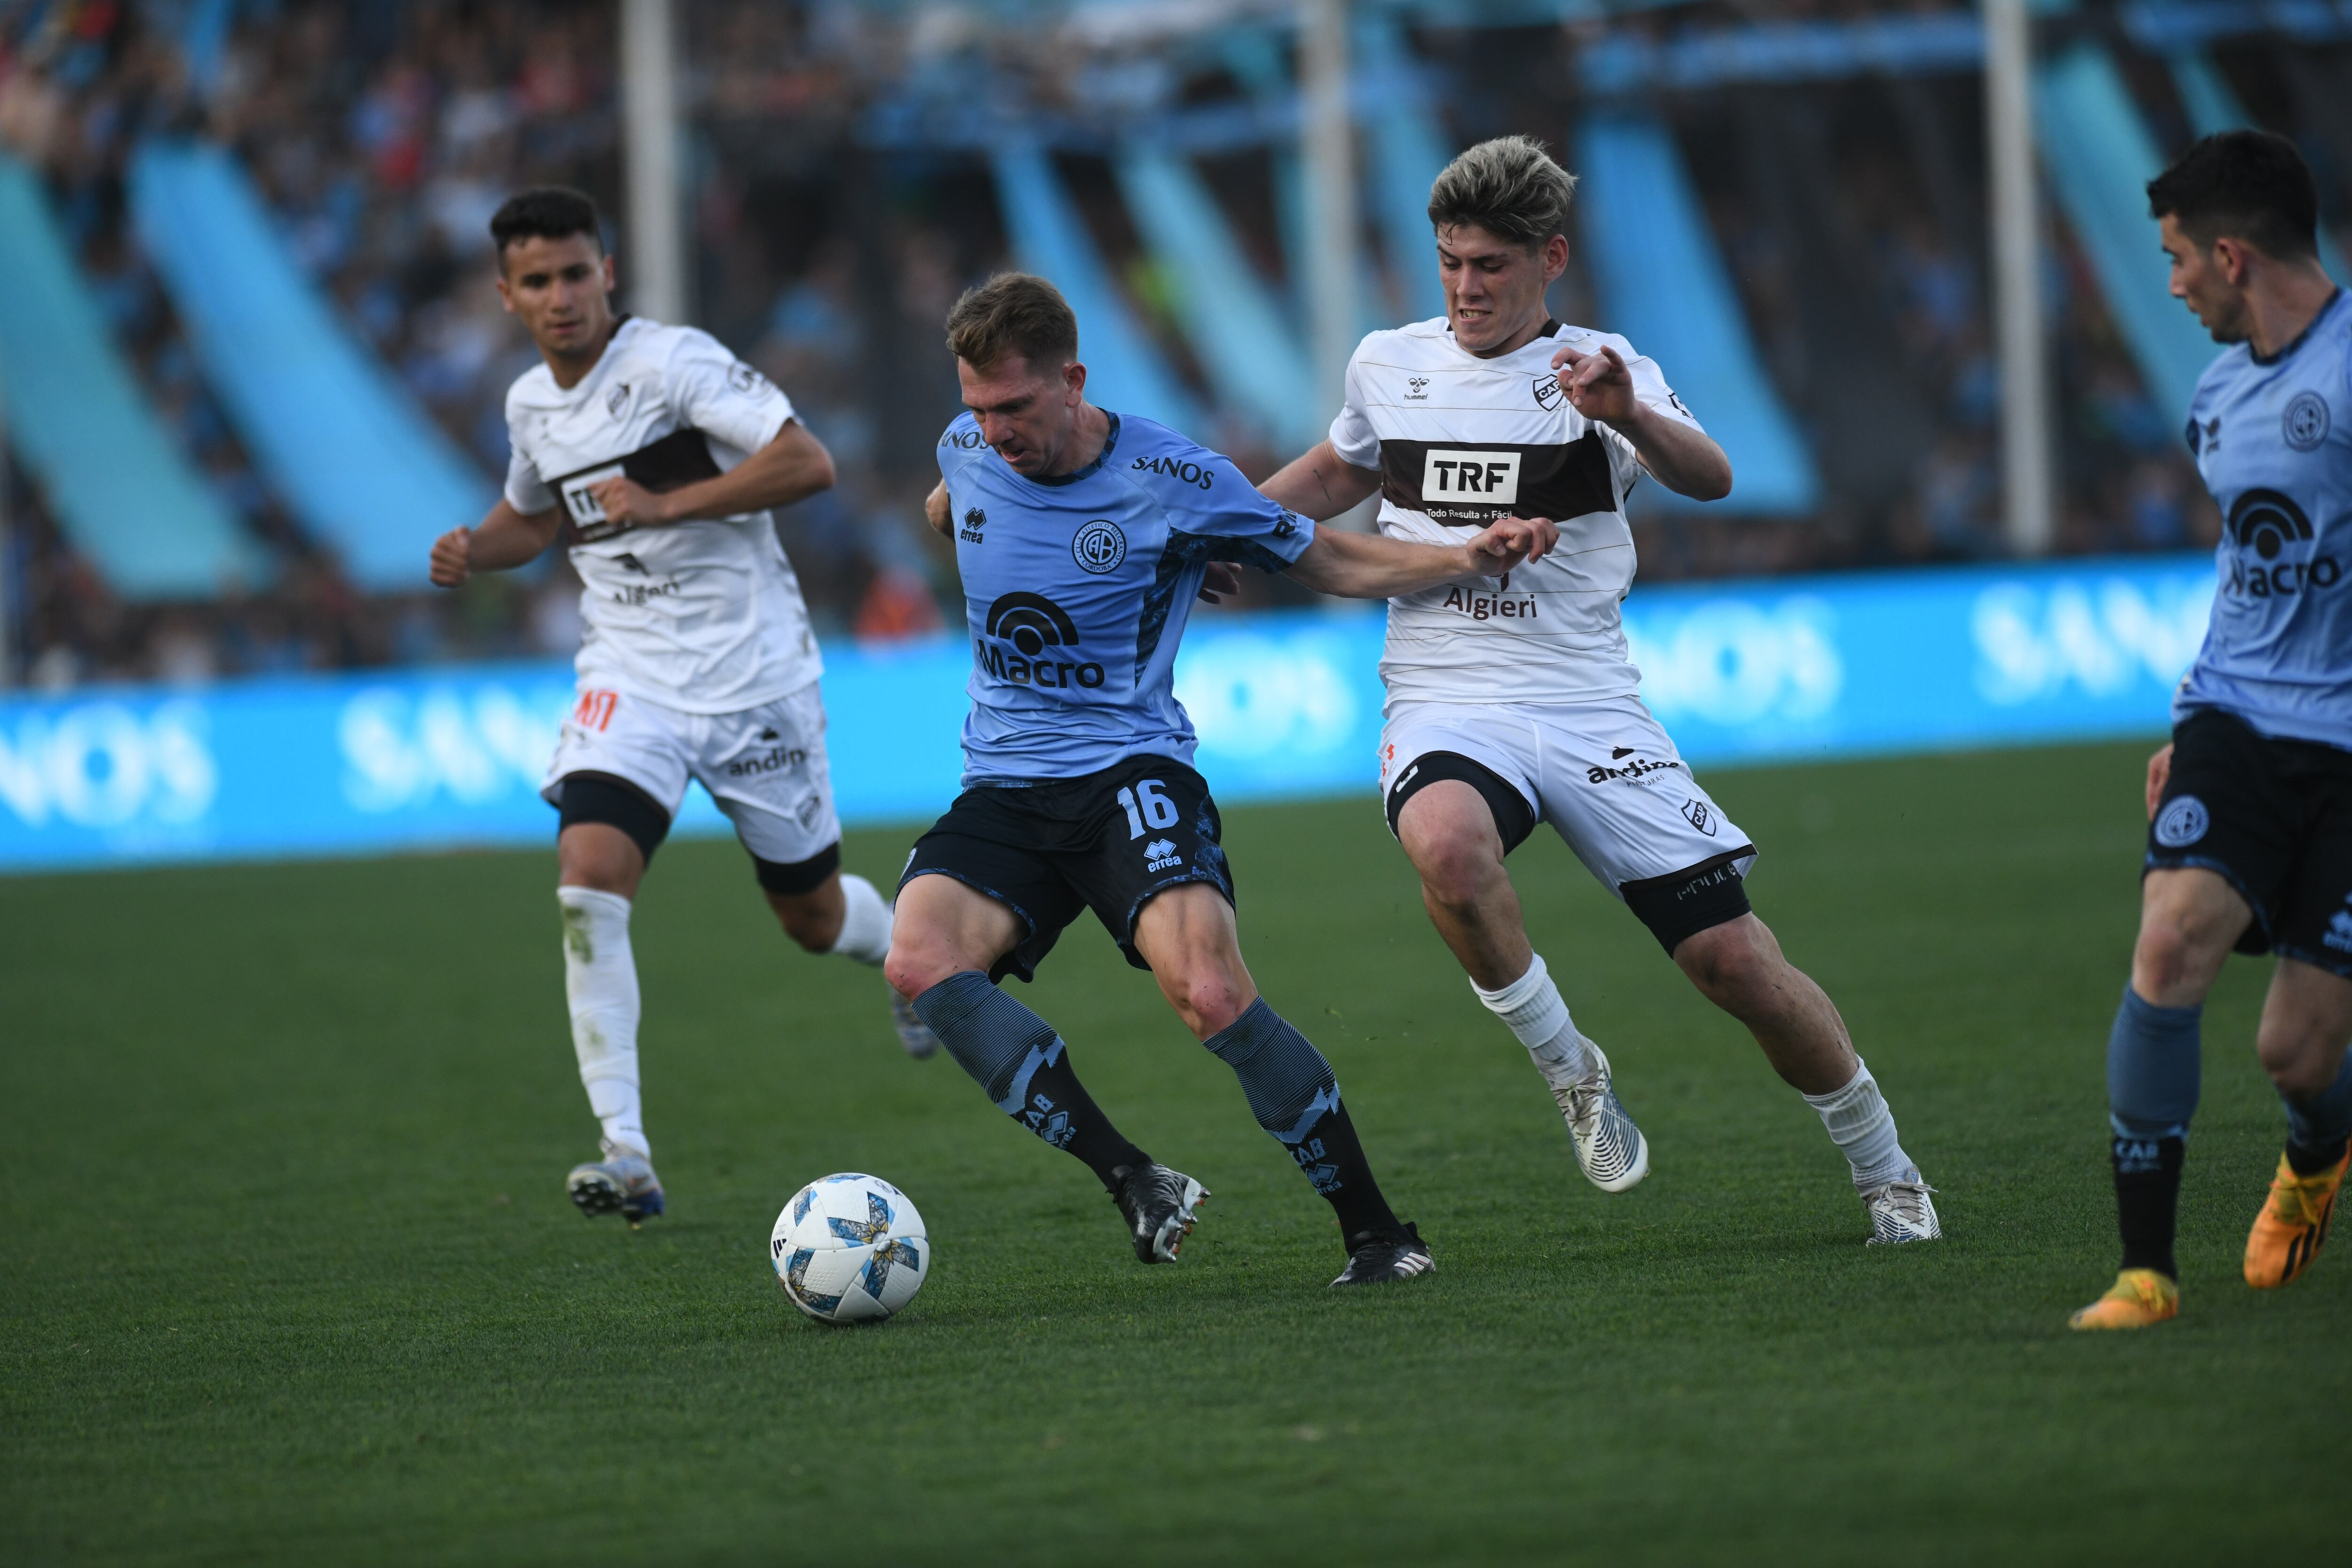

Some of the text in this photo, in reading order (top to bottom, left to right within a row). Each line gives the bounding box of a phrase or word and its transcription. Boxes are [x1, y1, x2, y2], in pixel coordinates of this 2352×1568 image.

[1131, 456, 1215, 490] SANOS
[1433, 460, 1510, 493] TRF
[1426, 509, 1447, 517] Todo
[1448, 509, 1480, 519] Resulta
[1491, 510, 1512, 519] Fácil
[960, 528, 984, 544] errea
[1082, 522, 1110, 536] ATLETICO
[1110, 526, 1123, 560] BELGRANO
[1082, 560, 1112, 571] CORDOBA
[1443, 587, 1537, 621] Algieri
[977, 639, 1105, 689] Macro
[1117, 779, 1179, 841] 16
[1694, 804, 1707, 826] CAP
[1148, 856, 1182, 873] errea
